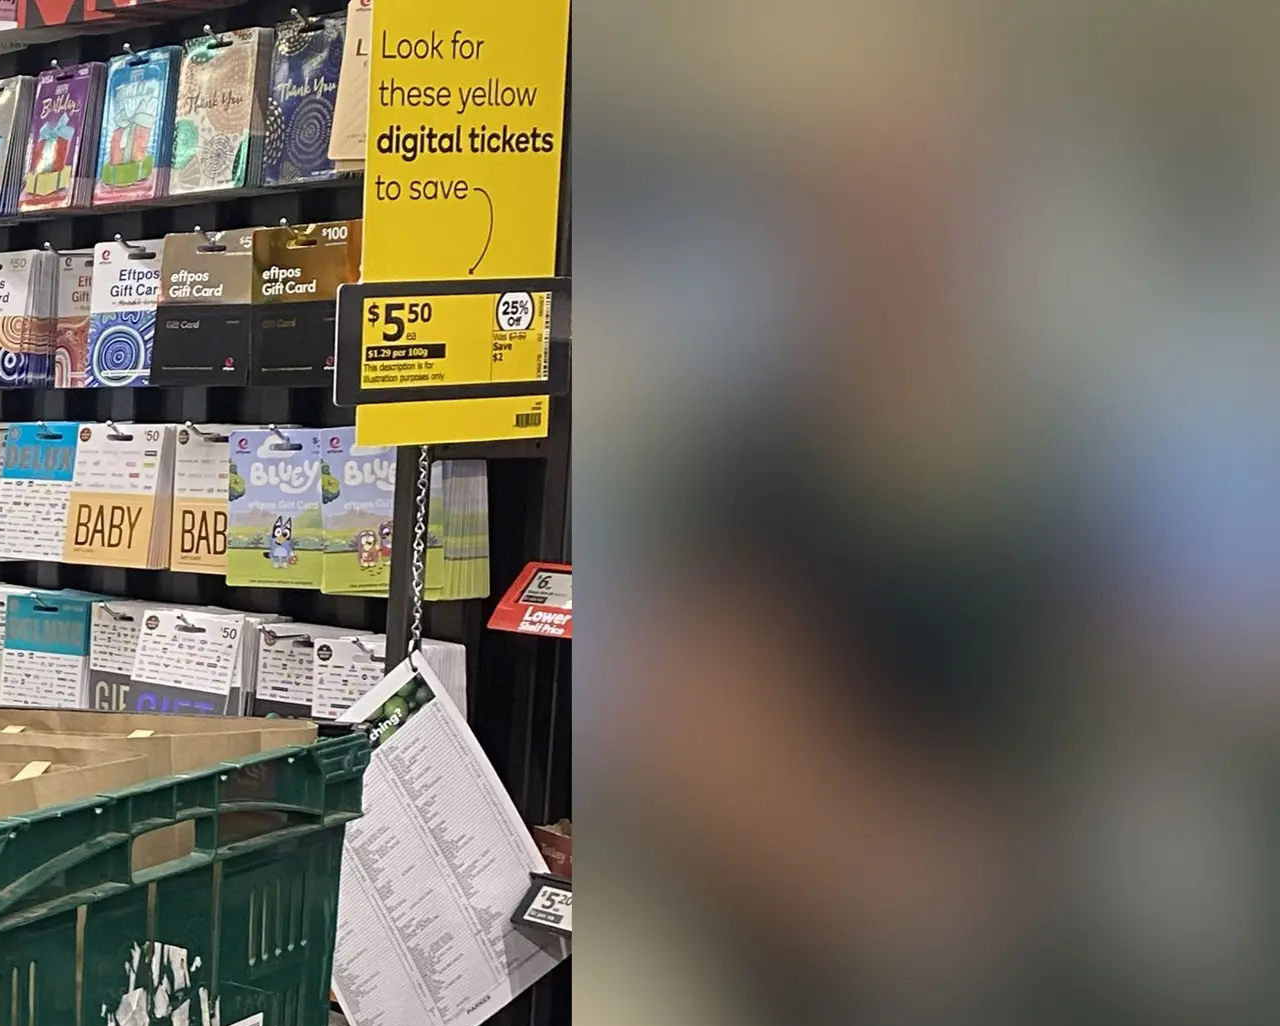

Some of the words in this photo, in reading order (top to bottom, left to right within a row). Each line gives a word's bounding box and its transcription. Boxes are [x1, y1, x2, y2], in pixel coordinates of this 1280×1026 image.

[382, 30, 444, 59] Look
[451, 30, 485, 59] for
[277, 78, 311, 100] Thank
[314, 77, 337, 98] You
[186, 91, 218, 113] Thank
[222, 93, 244, 108] You
[379, 78, 451, 107] these
[456, 78, 538, 114] yellow
[40, 98, 80, 119] Birthday
[377, 125, 463, 162] digital
[468, 125, 554, 153] tickets
[375, 175, 401, 201] to
[409, 180, 468, 200] save
[322, 226, 348, 240] $100
[10, 258, 27, 269] $50
[119, 269, 160, 282] Eftpos
[171, 270, 209, 284] eftpos
[262, 265, 301, 282] eftpos
[110, 285, 132, 297] Gift
[169, 285, 191, 298] Gift
[192, 284, 223, 297] Card
[262, 282, 284, 295] Gift
[286, 280, 316, 294] Card
[72, 291, 90, 303] Gift
[502, 300, 529, 316] 25%
[181, 320, 200, 329] Card
[507, 316, 522, 326] Off
[367, 348, 391, 359] $1.29
[493, 342, 513, 351] Save
[493, 353, 503, 362] $2
[364, 363, 378, 372] This
[379, 363, 416, 373] description
[417, 362, 423, 370] is
[424, 362, 434, 370] for
[363, 374, 398, 383] illustration
[400, 374, 429, 383] purposes
[430, 373, 444, 381] only
[144, 430, 160, 442] $50
[6, 446, 74, 471] DELUX
[250, 460, 321, 494] BLUEY
[74, 504, 143, 549] BABY
[181, 510, 227, 556] BAB
[523, 606, 572, 625] Lower
[8, 618, 81, 645] DELUXE
[221, 627, 237, 639] $50
[517, 622, 542, 634] Shelf
[542, 624, 565, 635] Price
